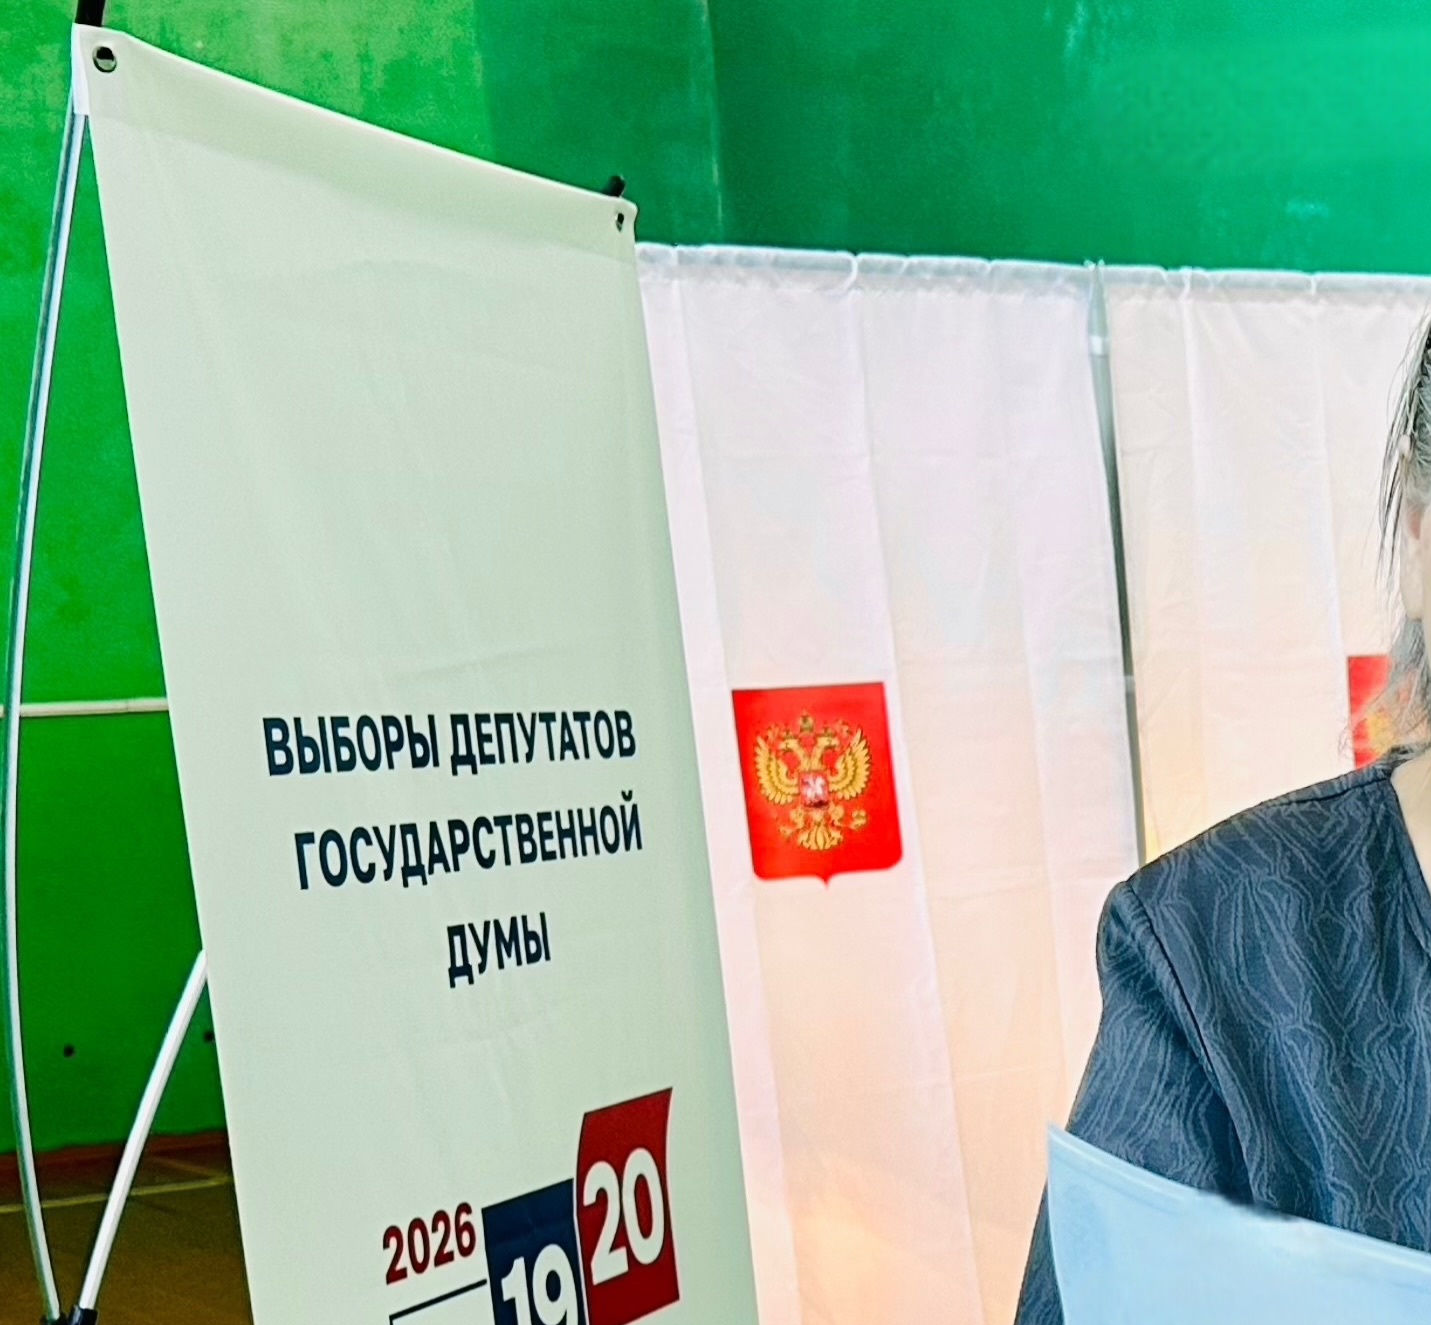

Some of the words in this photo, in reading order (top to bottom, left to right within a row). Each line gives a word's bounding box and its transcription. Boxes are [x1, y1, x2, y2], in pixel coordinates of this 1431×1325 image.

[262, 714, 440, 776] ВЫБОРЫ
[449, 709, 637, 776] ДЕПУТАТОВ
[294, 789, 643, 890] ГОСУДАРСТВЕННОЙ
[446, 911, 551, 988] ДУМЫ
[382, 1202, 477, 1285] 2026
[582, 1146, 665, 1286] 20
